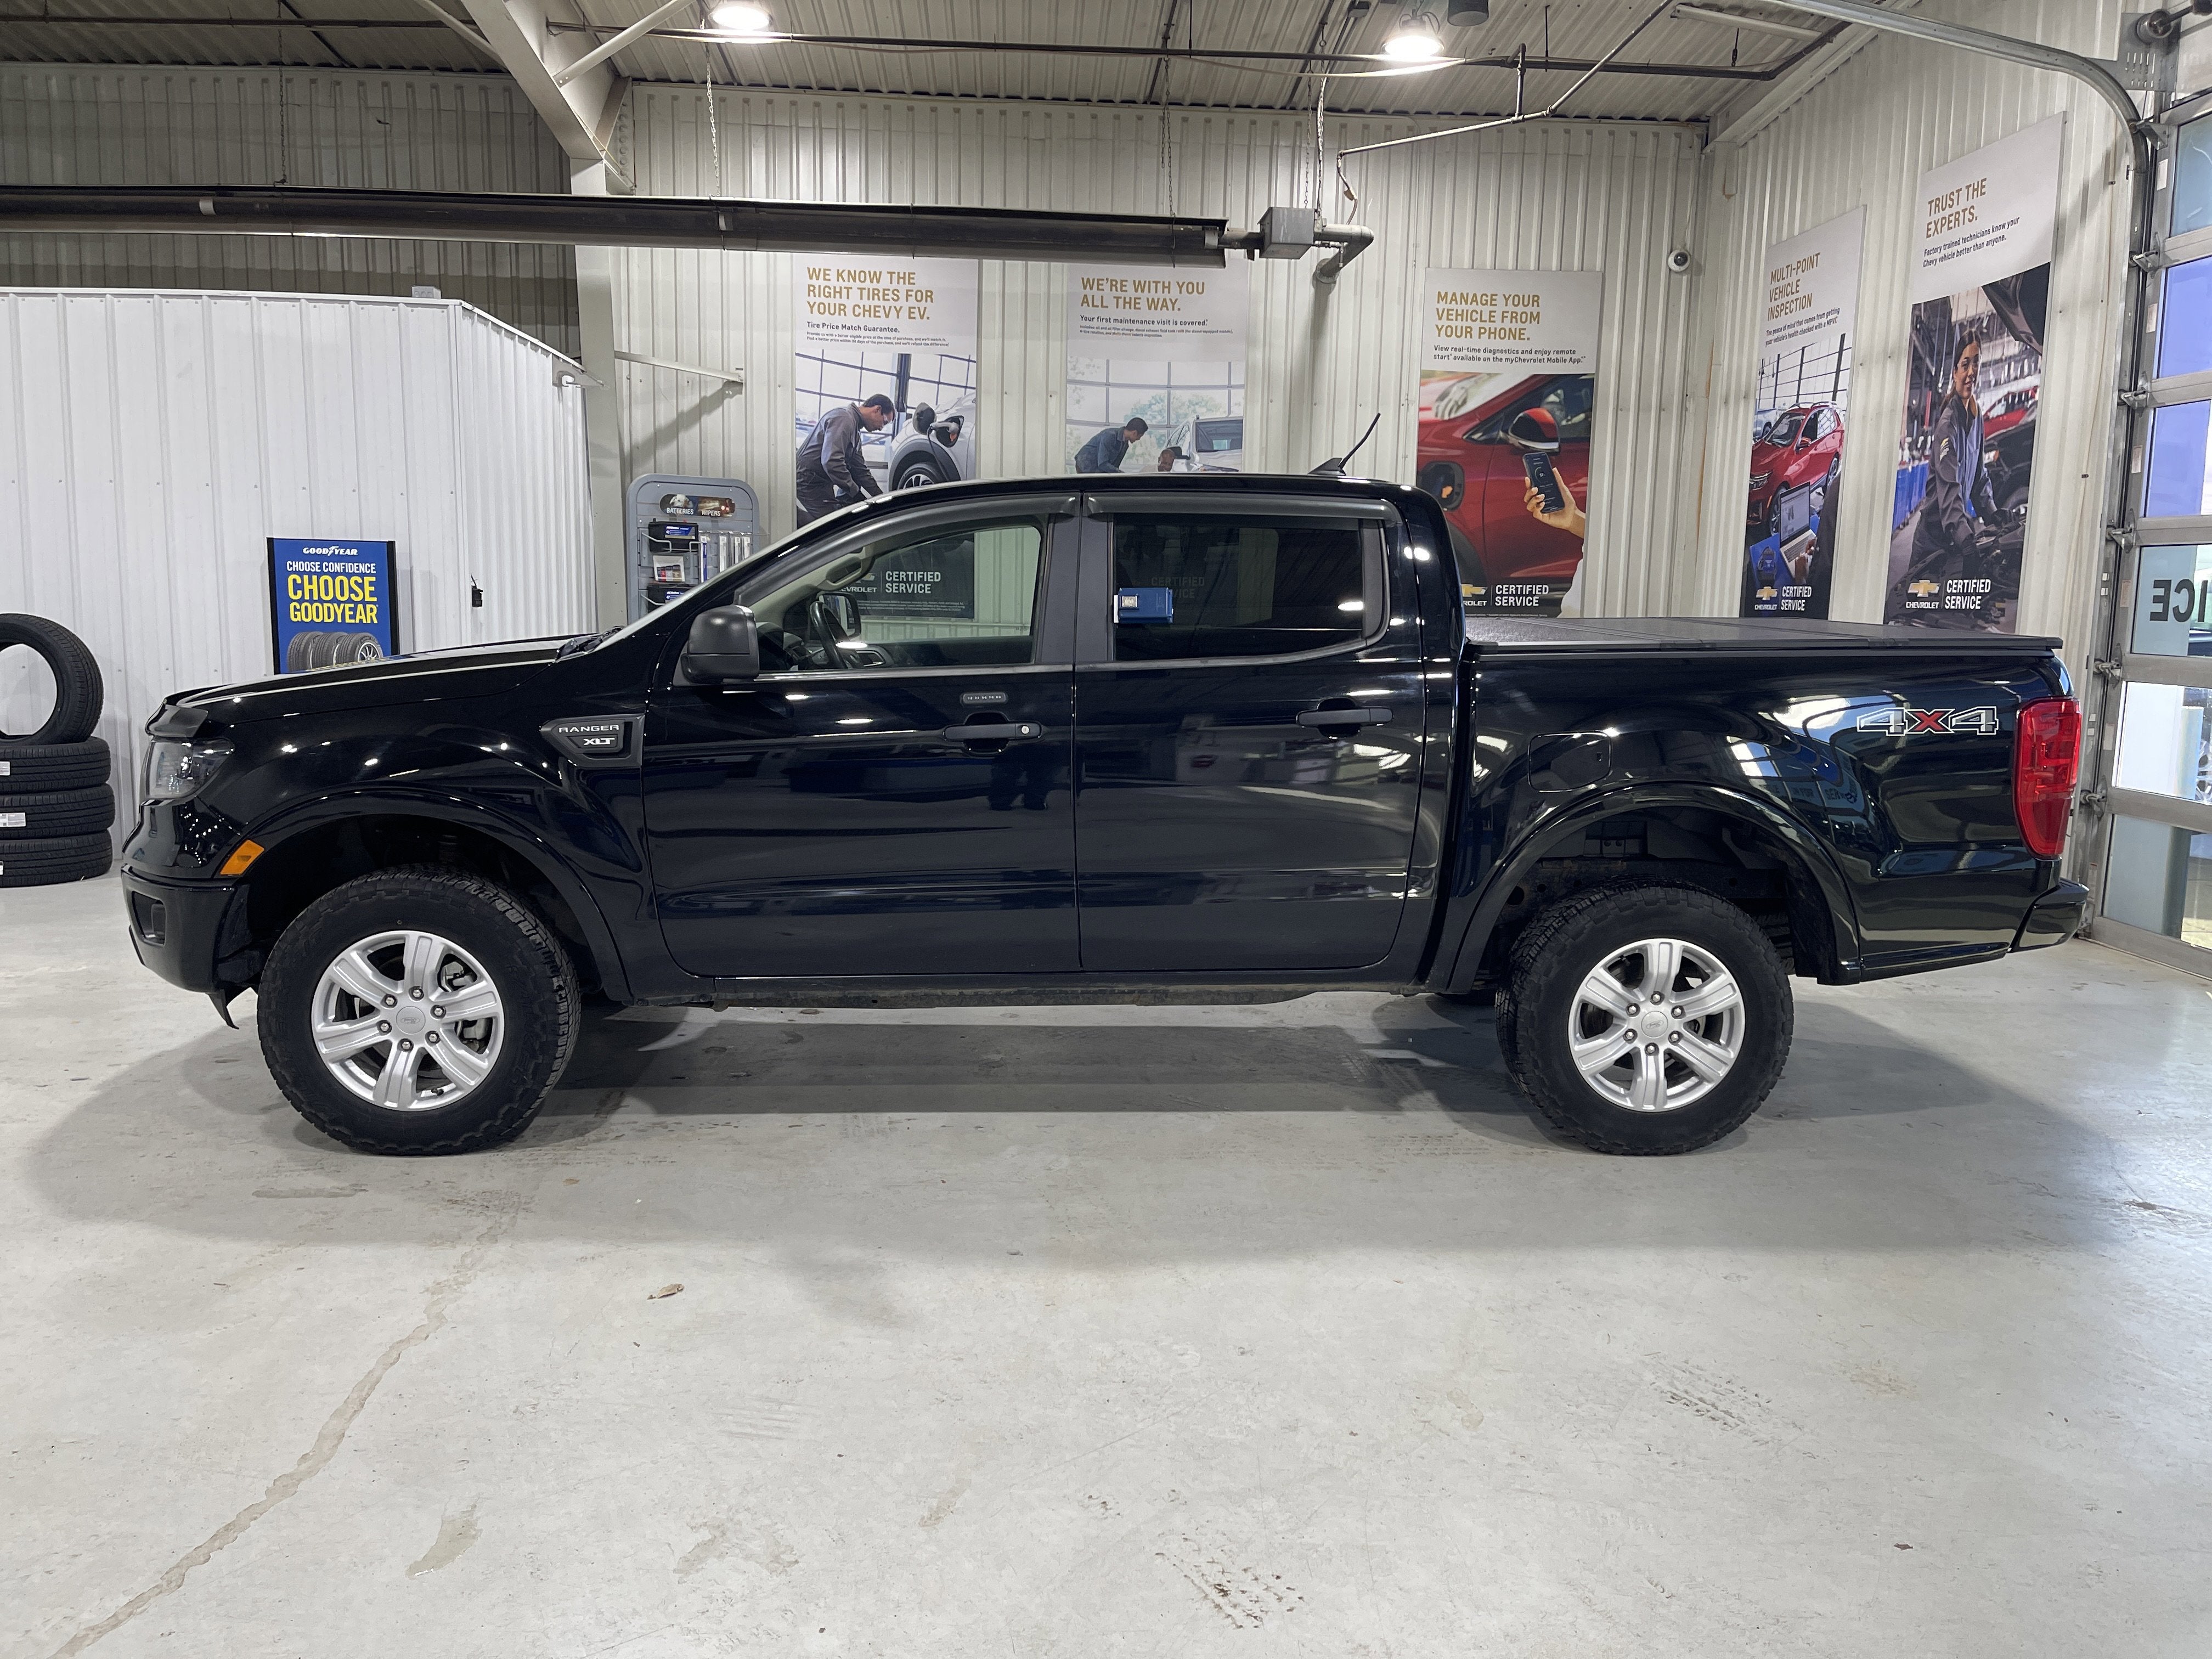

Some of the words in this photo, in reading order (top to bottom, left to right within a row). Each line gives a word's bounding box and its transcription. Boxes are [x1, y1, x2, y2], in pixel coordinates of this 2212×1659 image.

[1928, 188, 1962, 217] TRUST
[1966, 178, 1987, 202] THE
[1926, 206, 1978, 238] EXPERTS.
[1924, 246, 1942, 257] Factory
[1943, 238, 1960, 250] trained
[1962, 228, 1990, 244] technicians
[1991, 223, 2006, 233] know
[2007, 217, 2020, 230] your
[1923, 258, 1938, 268] Chevy
[1938, 251, 1955, 263] vehicle
[1956, 246, 1972, 257] better
[1973, 242, 1985, 251] than
[1986, 235, 2006, 247] anyone.
[1770, 252, 1820, 284] MULTI-POINT
[807, 267, 831, 281] WE
[837, 269, 882, 284] KNOW
[887, 271, 916, 285] THE
[808, 284, 853, 300] RIGHT
[857, 287, 900, 302] TIRES
[906, 289, 934, 303] FOR
[1081, 277, 1128, 292] WE'RE
[1133, 280, 1171, 294] WITH
[1176, 281, 1205, 295] YOU
[1769, 279, 1801, 303] VEHICLE
[1081, 294, 1108, 308] ALL
[1114, 296, 1142, 310] THE
[1147, 297, 1181, 312] WAY.
[1437, 291, 1498, 306] MANAGE
[1503, 294, 1541, 308] YOUR
[1768, 293, 1812, 321] INSPECTION
[807, 301, 847, 317] YOUR
[852, 304, 903, 319] CHEVY
[908, 306, 930, 320] EV.
[1436, 308, 1496, 323] VEHICLE
[1501, 310, 1541, 324] FROM
[1826, 308, 1840, 319] getting
[1113, 317, 1155, 325] maintenance
[864, 325, 900, 333] Guarantee.
[1435, 324, 1473, 339] YOUR
[1478, 327, 1530, 341] PHONE.
[303, 546, 358, 556] GOODYEAR
[286, 561, 320, 572] CHOOSE
[323, 562, 376, 573] CONFIDENCE
[885, 571, 941, 582] CERTIFIED
[1151, 577, 1205, 586] CERTIFIED
[287, 574, 377, 602] CHOOSE
[885, 583, 932, 594] SERVICE
[1496, 584, 1549, 595] CERTIFIED
[1782, 586, 1812, 597] CERTIFIED
[1947, 579, 1991, 593] CERTIFIED
[1173, 589, 1195, 599] VICE
[1495, 596, 1539, 606] SERVICE
[1781, 600, 1805, 611] SERVICE
[1945, 596, 1982, 609] SERVICE
[290, 602, 378, 624] GOODYEAR
[559, 725, 619, 733] RANGER
[583, 737, 615, 746] XLT
